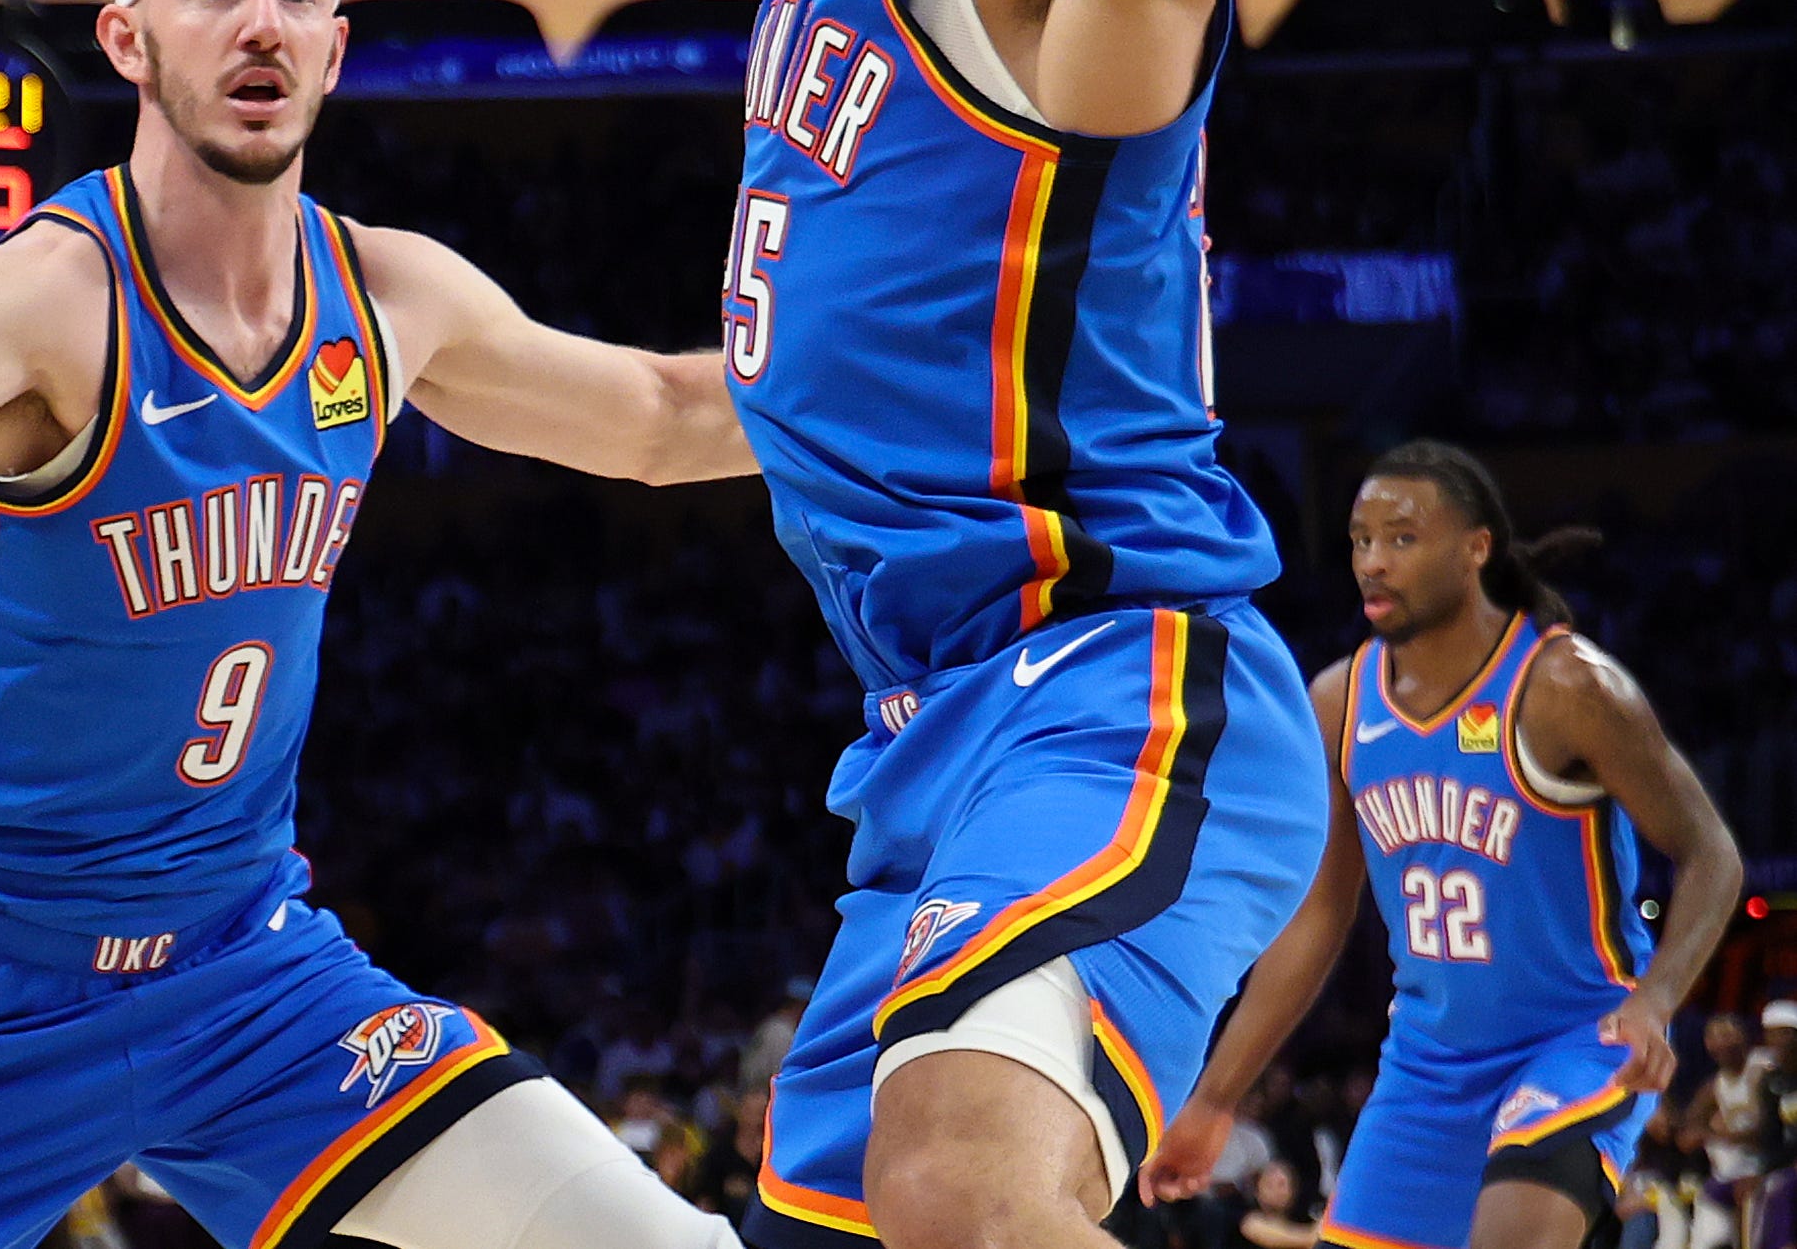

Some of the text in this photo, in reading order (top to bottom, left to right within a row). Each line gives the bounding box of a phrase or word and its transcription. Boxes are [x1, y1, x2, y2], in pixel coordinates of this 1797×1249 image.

[722, 184, 792, 387] 5
[89, 472, 364, 621] THUNDE
[176, 639, 274, 788] 9
[1353, 771, 1522, 866] THUNDER
[1402, 863, 1494, 964] 22
